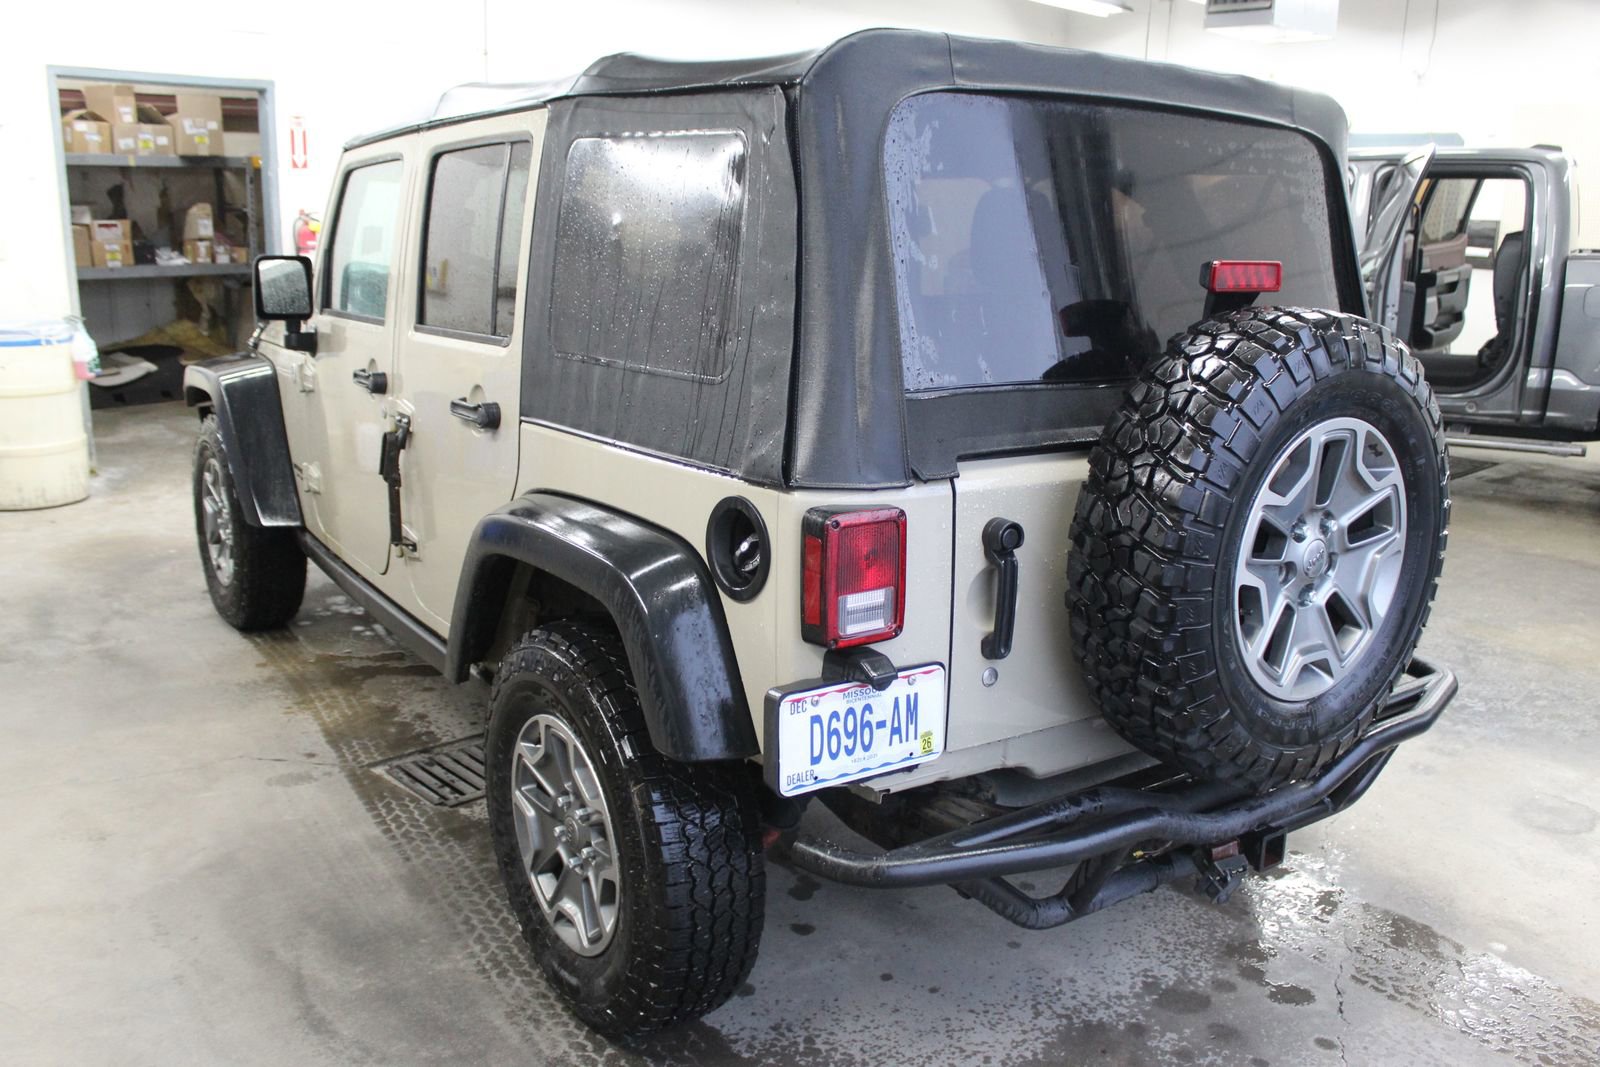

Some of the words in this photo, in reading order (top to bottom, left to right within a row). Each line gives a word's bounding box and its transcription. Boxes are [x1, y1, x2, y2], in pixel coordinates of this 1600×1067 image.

[842, 687, 878, 701] MISSOU
[790, 701, 808, 716] DEC
[810, 692, 919, 766] D696-AM
[922, 737, 932, 750] 26
[786, 769, 815, 787] DEALER
